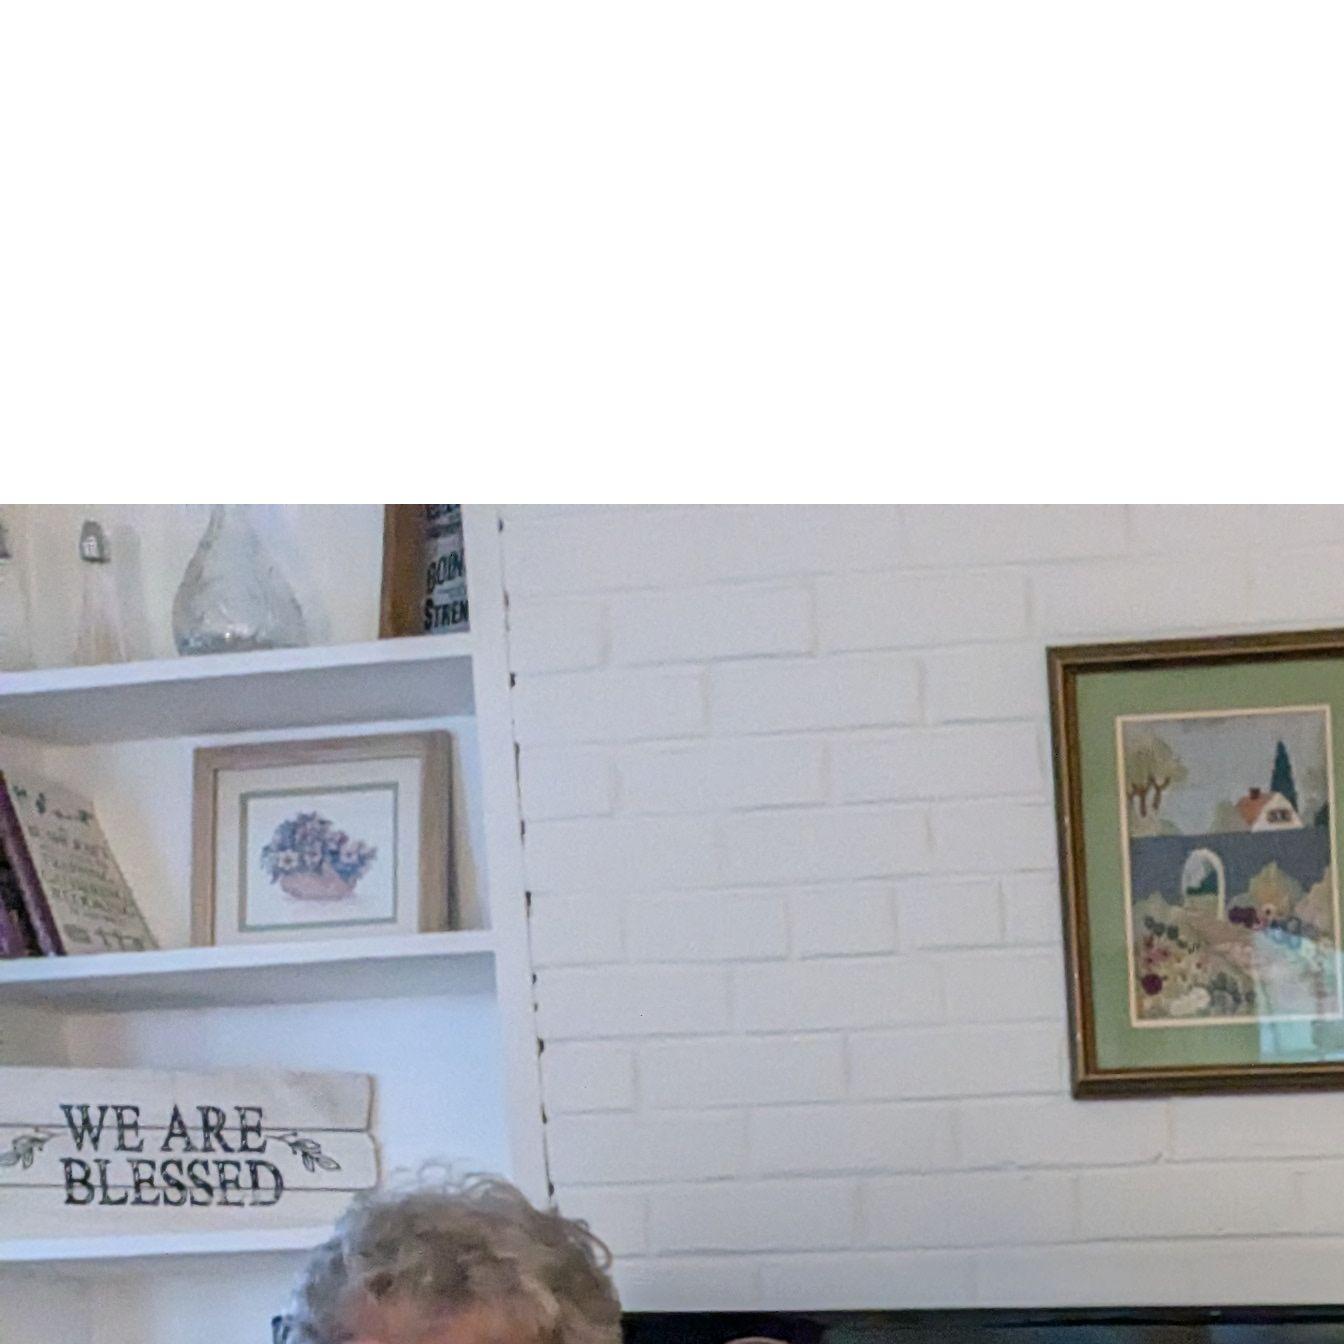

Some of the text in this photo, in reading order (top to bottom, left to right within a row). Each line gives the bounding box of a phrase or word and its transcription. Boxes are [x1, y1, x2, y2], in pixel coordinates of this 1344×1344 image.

[59, 1103, 268, 1152] WE ARE
[59, 1157, 285, 1206] BLESSED
